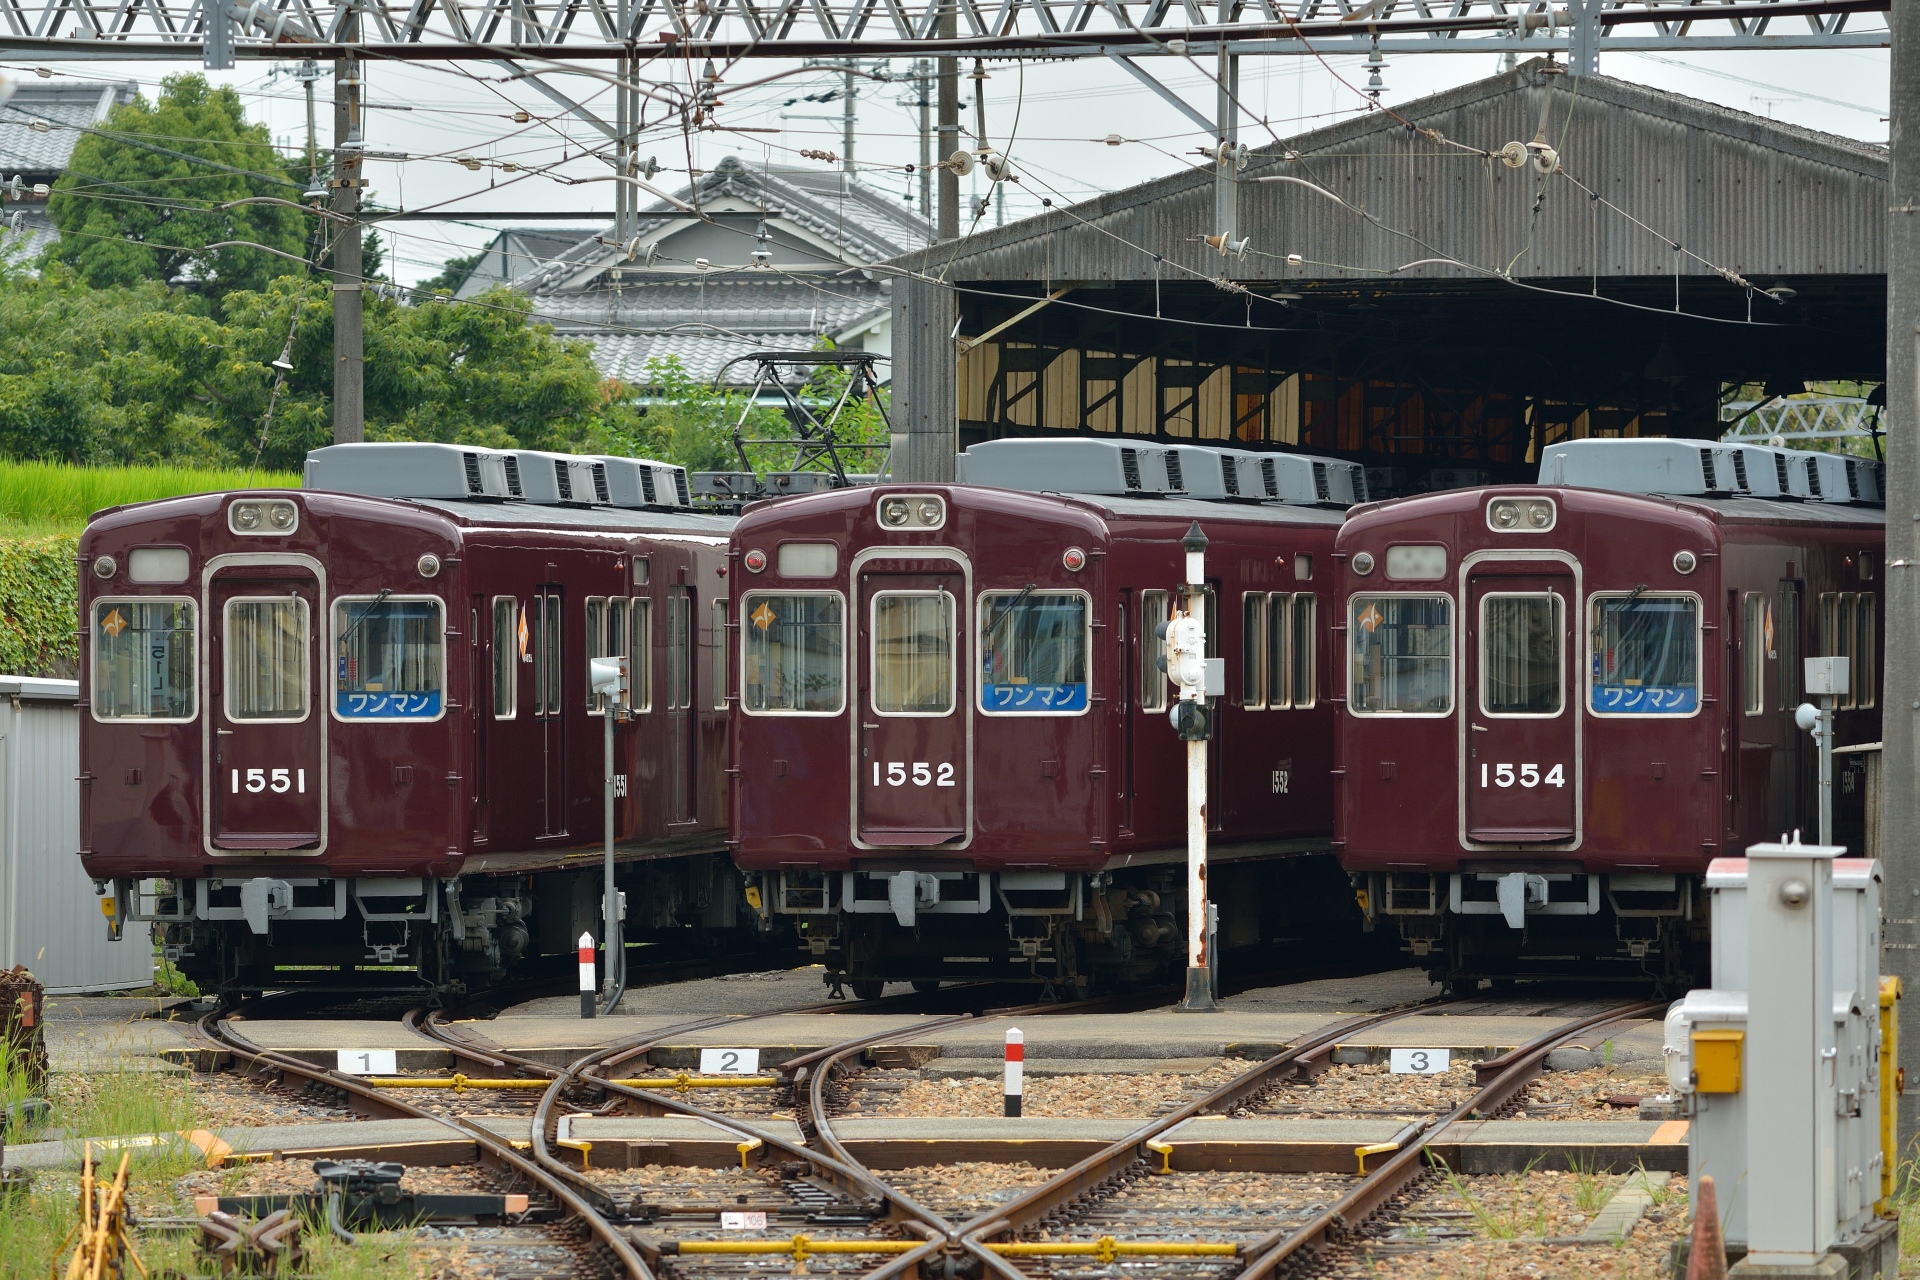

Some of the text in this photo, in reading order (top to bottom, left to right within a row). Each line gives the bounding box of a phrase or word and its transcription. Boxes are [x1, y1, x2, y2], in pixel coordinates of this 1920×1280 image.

[349, 694, 428, 713] ワンマン
[995, 687, 1074, 706] ワンマン
[1604, 688, 1684, 708] ワンマン
[231, 769, 305, 794] 1551
[873, 762, 956, 787] 1552
[1272, 770, 1288, 794] 1552
[1481, 763, 1566, 788] 1554
[613, 774, 627, 798] 1551
[358, 1053, 370, 1071] 1
[721, 1052, 739, 1071] 2
[1410, 1051, 1429, 1071] 3
[747, 1215, 764, 1226] 106
